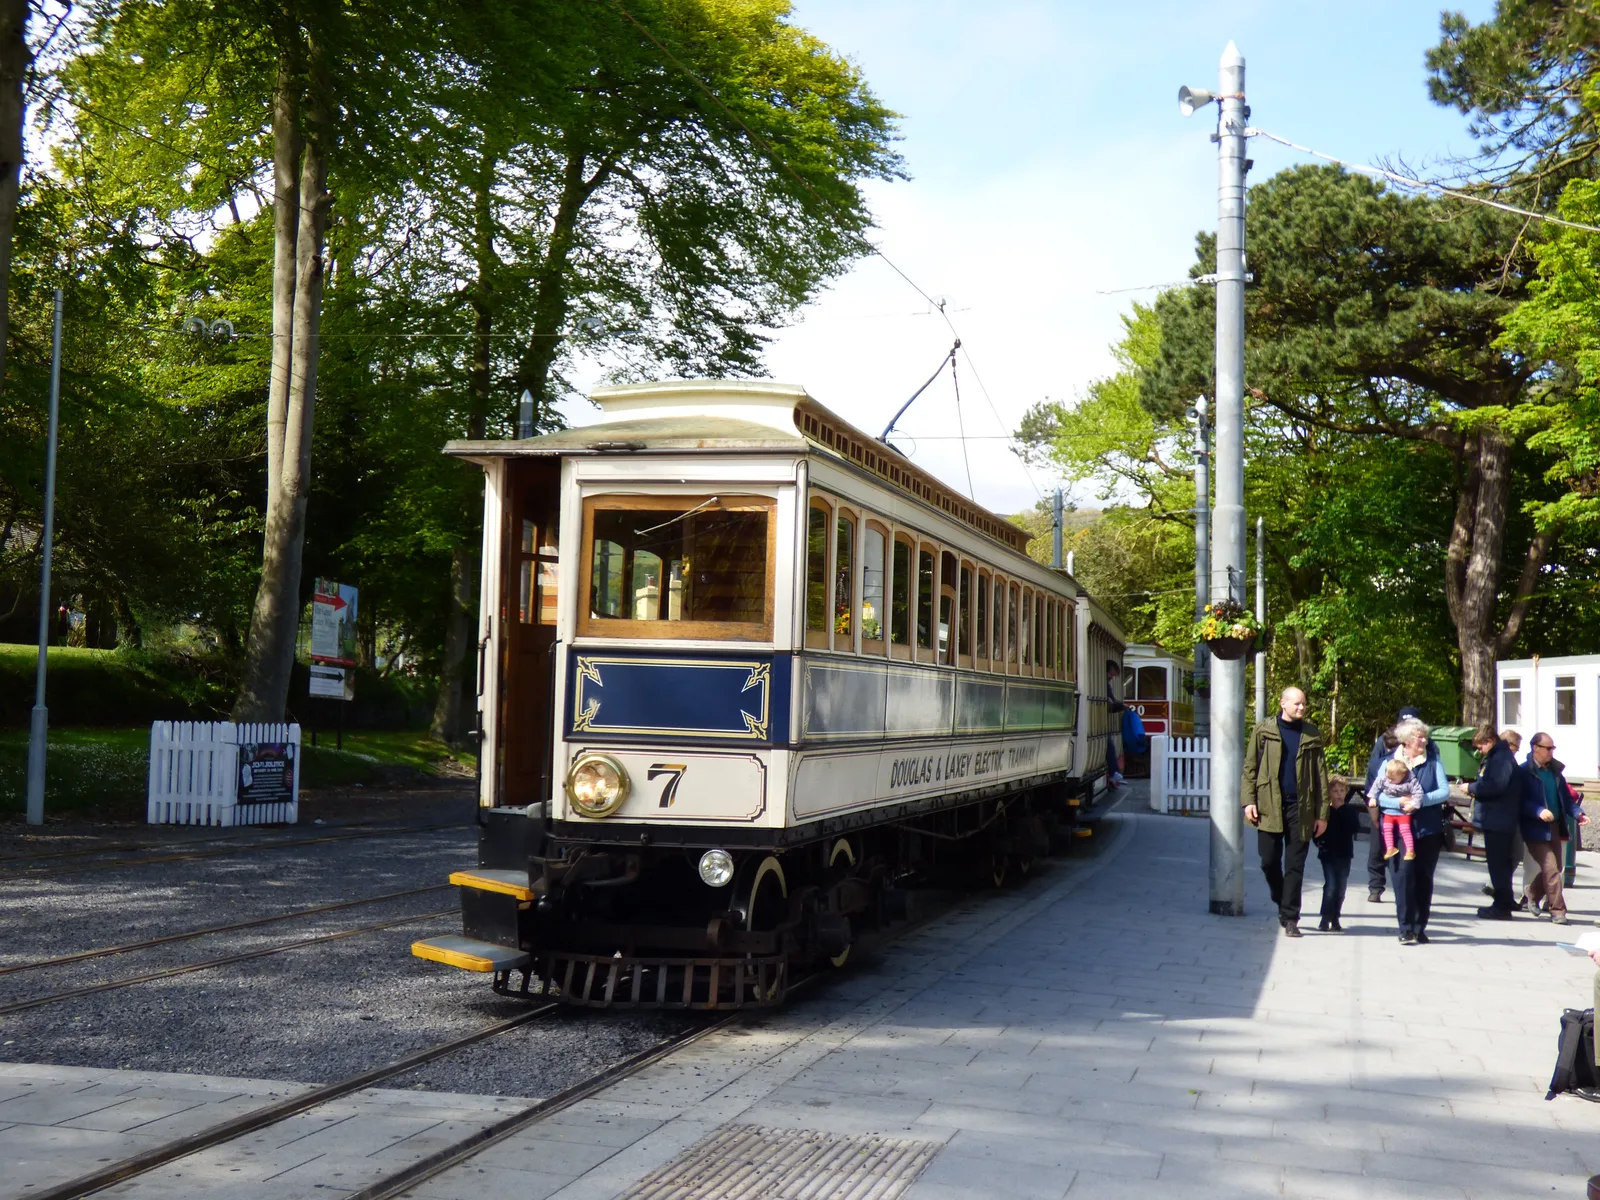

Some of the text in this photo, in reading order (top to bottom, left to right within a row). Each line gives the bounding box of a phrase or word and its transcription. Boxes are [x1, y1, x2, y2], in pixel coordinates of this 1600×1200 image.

[647, 763, 687, 808] 7
[890, 756, 934, 789] DOUGLAS
[935, 755, 942, 782] &
[945, 752, 973, 781] LAXEY
[974, 748, 1005, 776] ELECTRIC
